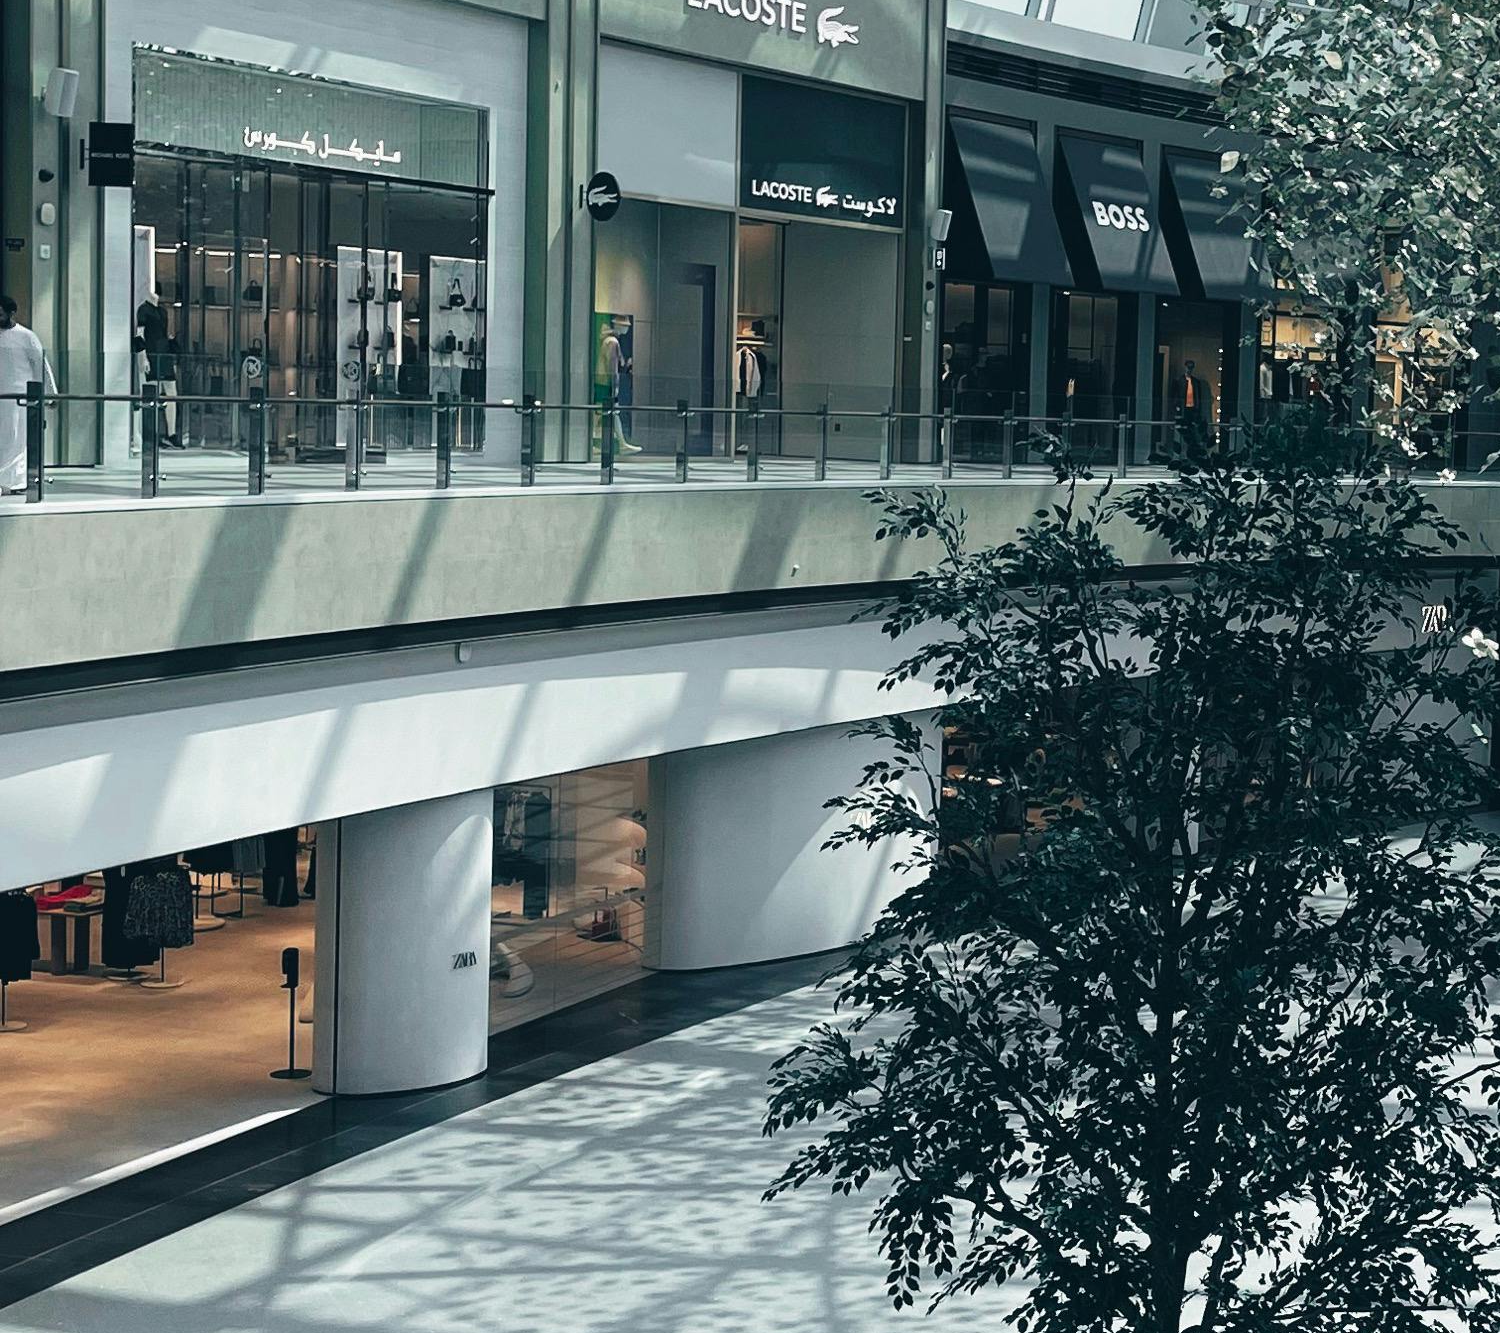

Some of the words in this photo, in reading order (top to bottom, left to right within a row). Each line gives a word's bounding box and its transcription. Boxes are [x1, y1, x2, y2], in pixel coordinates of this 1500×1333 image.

[318, 133, 401, 167] مايكل
[751, 179, 813, 203] LACOSTE
[842, 193, 897, 218] لاكوست
[1092, 201, 1150, 233] BOSS
